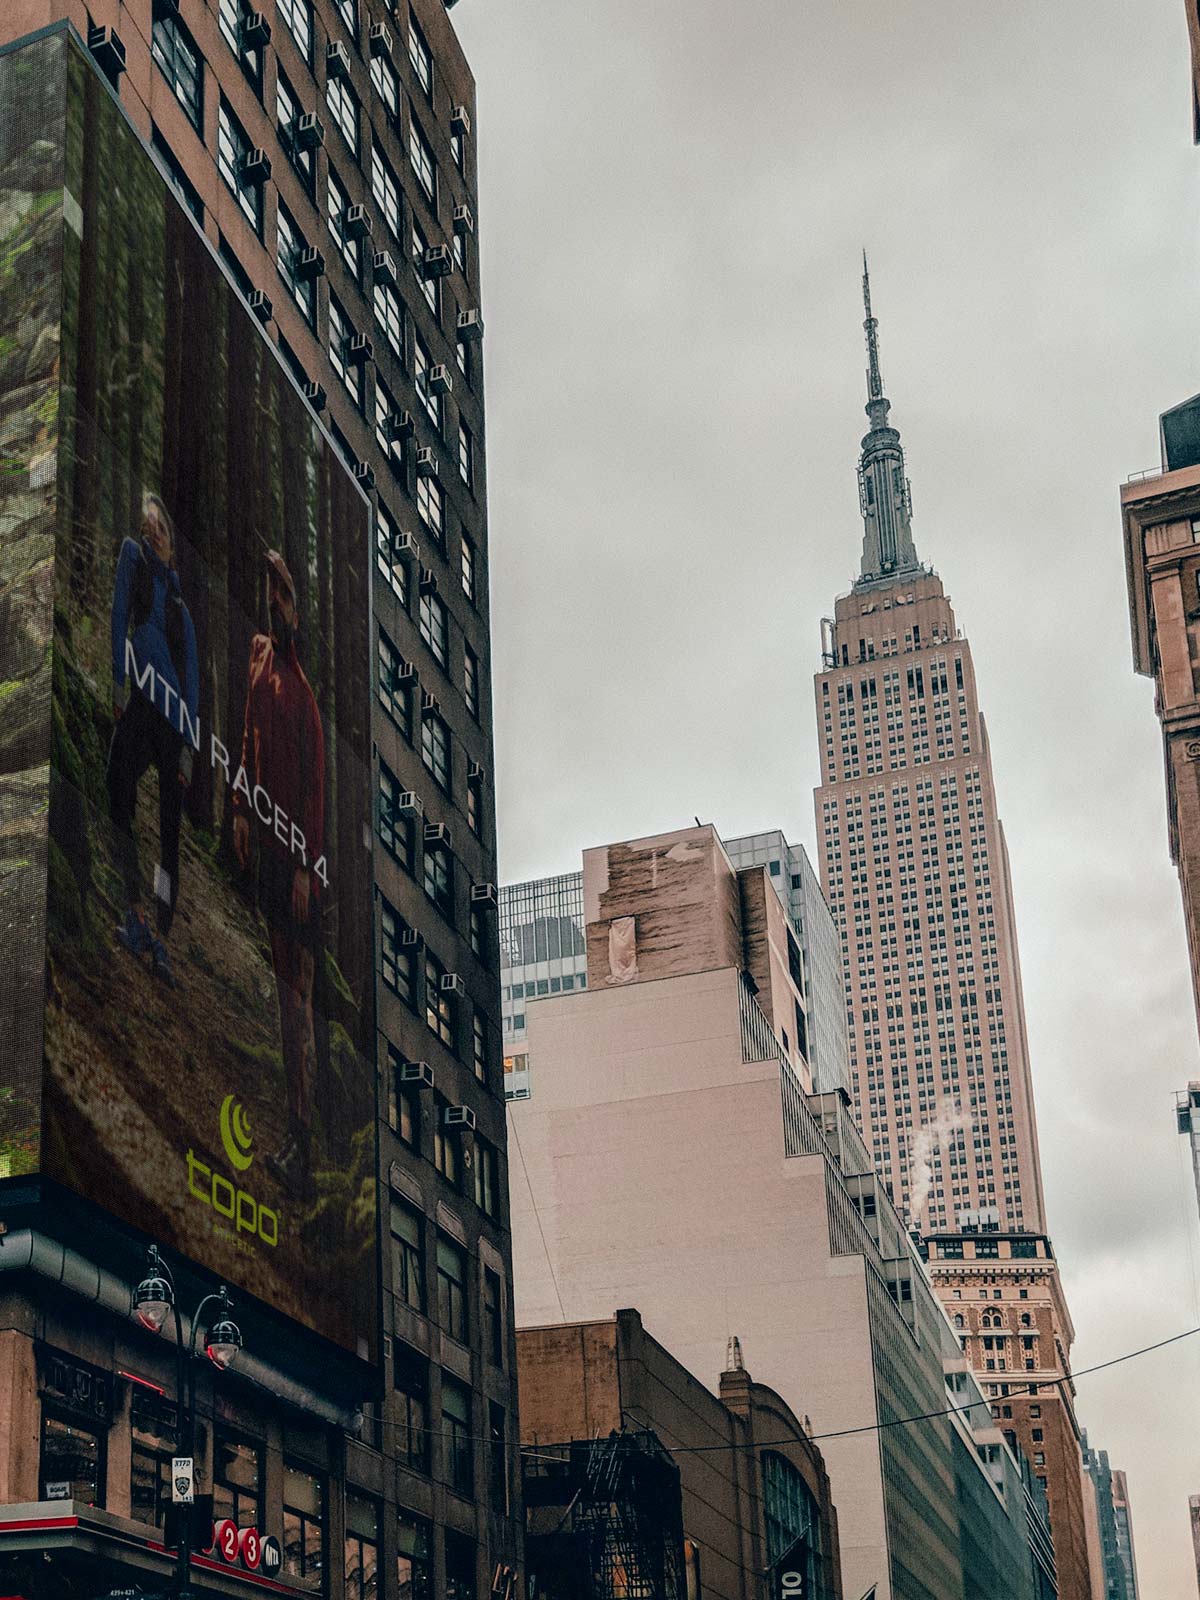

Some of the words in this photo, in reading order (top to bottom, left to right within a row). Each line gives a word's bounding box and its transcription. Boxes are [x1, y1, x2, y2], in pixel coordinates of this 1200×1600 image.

[125, 638, 199, 750] MTN
[211, 734, 306, 866] RACER
[314, 856, 329, 888] 4
[186, 1148, 278, 1246] topo
[225, 1527, 235, 1556] 2
[248, 1535, 257, 1563] 3
